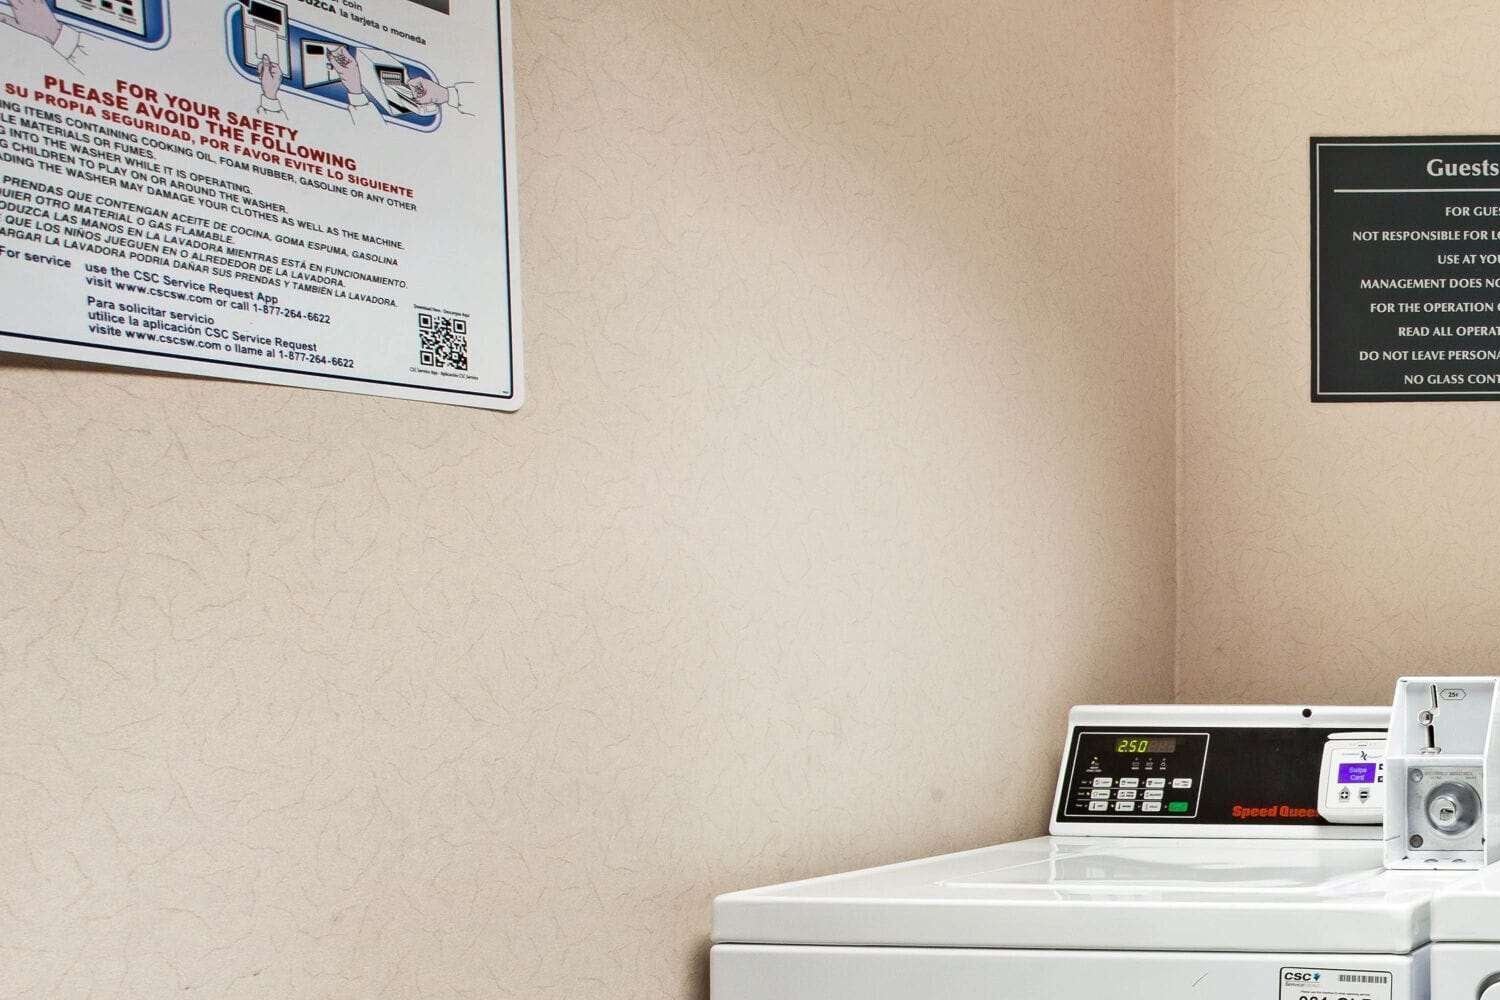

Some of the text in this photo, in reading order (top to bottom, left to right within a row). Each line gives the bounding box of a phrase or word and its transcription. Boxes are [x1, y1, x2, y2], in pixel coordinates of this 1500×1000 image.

[116, 79, 298, 141] FOR YOUR SAFETY
[44, 75, 356, 171] PLEASE AVOID THE FOLLOWING
[5, 83, 413, 198] SU PROPIA SEGURIDAD, POR FAVOR EVITE LO SIGUIENTE
[9, 128, 252, 194] INTO THE WASHER WHILE IT IS OPERATING.
[24, 106, 62, 124] ITEMS
[65, 117, 138, 143] CONTAINING
[141, 137, 193, 157] COOKING
[219, 156, 250, 171] FOAM
[299, 177, 348, 195] GASOLINE
[350, 189, 364, 199] OR
[366, 193, 384, 203] ANY
[386, 198, 416, 211] OTHER
[1426, 158, 1499, 176] Guests
[1445, 206, 1470, 216] FOR
[1352, 231, 1379, 241] NOT
[1382, 230, 1460, 240] RESPONSIBLE
[1463, 230, 1488, 240] FOR
[0, 245, 71, 268] For service
[1437, 254, 1459, 264] USE
[1462, 254, 1477, 264] AT
[85, 263, 278, 305] use the CSC Service Request App
[1360, 278, 1446, 288] MANAGEMENT
[1449, 278, 1482, 288] DOES
[86, 276, 330, 324] visit www.cscsw.com or call 1-877-264-6622
[87, 295, 214, 325] Para solicitar servicio
[1370, 302, 1395, 313] FOR
[1398, 302, 1420, 312] THE
[1423, 302, 1493, 312] OPERATION
[88, 311, 125, 324] utilice
[128, 315, 139, 326] la
[204, 327, 229, 339] CSC
[232, 331, 271, 345] Service
[274, 337, 317, 352] Request
[1398, 326, 1430, 336] READ
[1432, 326, 1453, 336] ALL
[88, 323, 122, 336] visite
[125, 330, 221, 350] www.cscsw.com
[234, 343, 263, 356] llame
[266, 348, 275, 358] al
[279, 350, 354, 368] 1-877-264-6622
[1359, 350, 1379, 360] DO
[1382, 350, 1408, 360] NOT
[1411, 350, 1445, 360] LEAVE
[1404, 374, 1424, 384] NO
[1427, 374, 1464, 384] GLASS
[1232, 805, 1318, 819] Speed Quee
[1284, 972, 1312, 981] CSC
